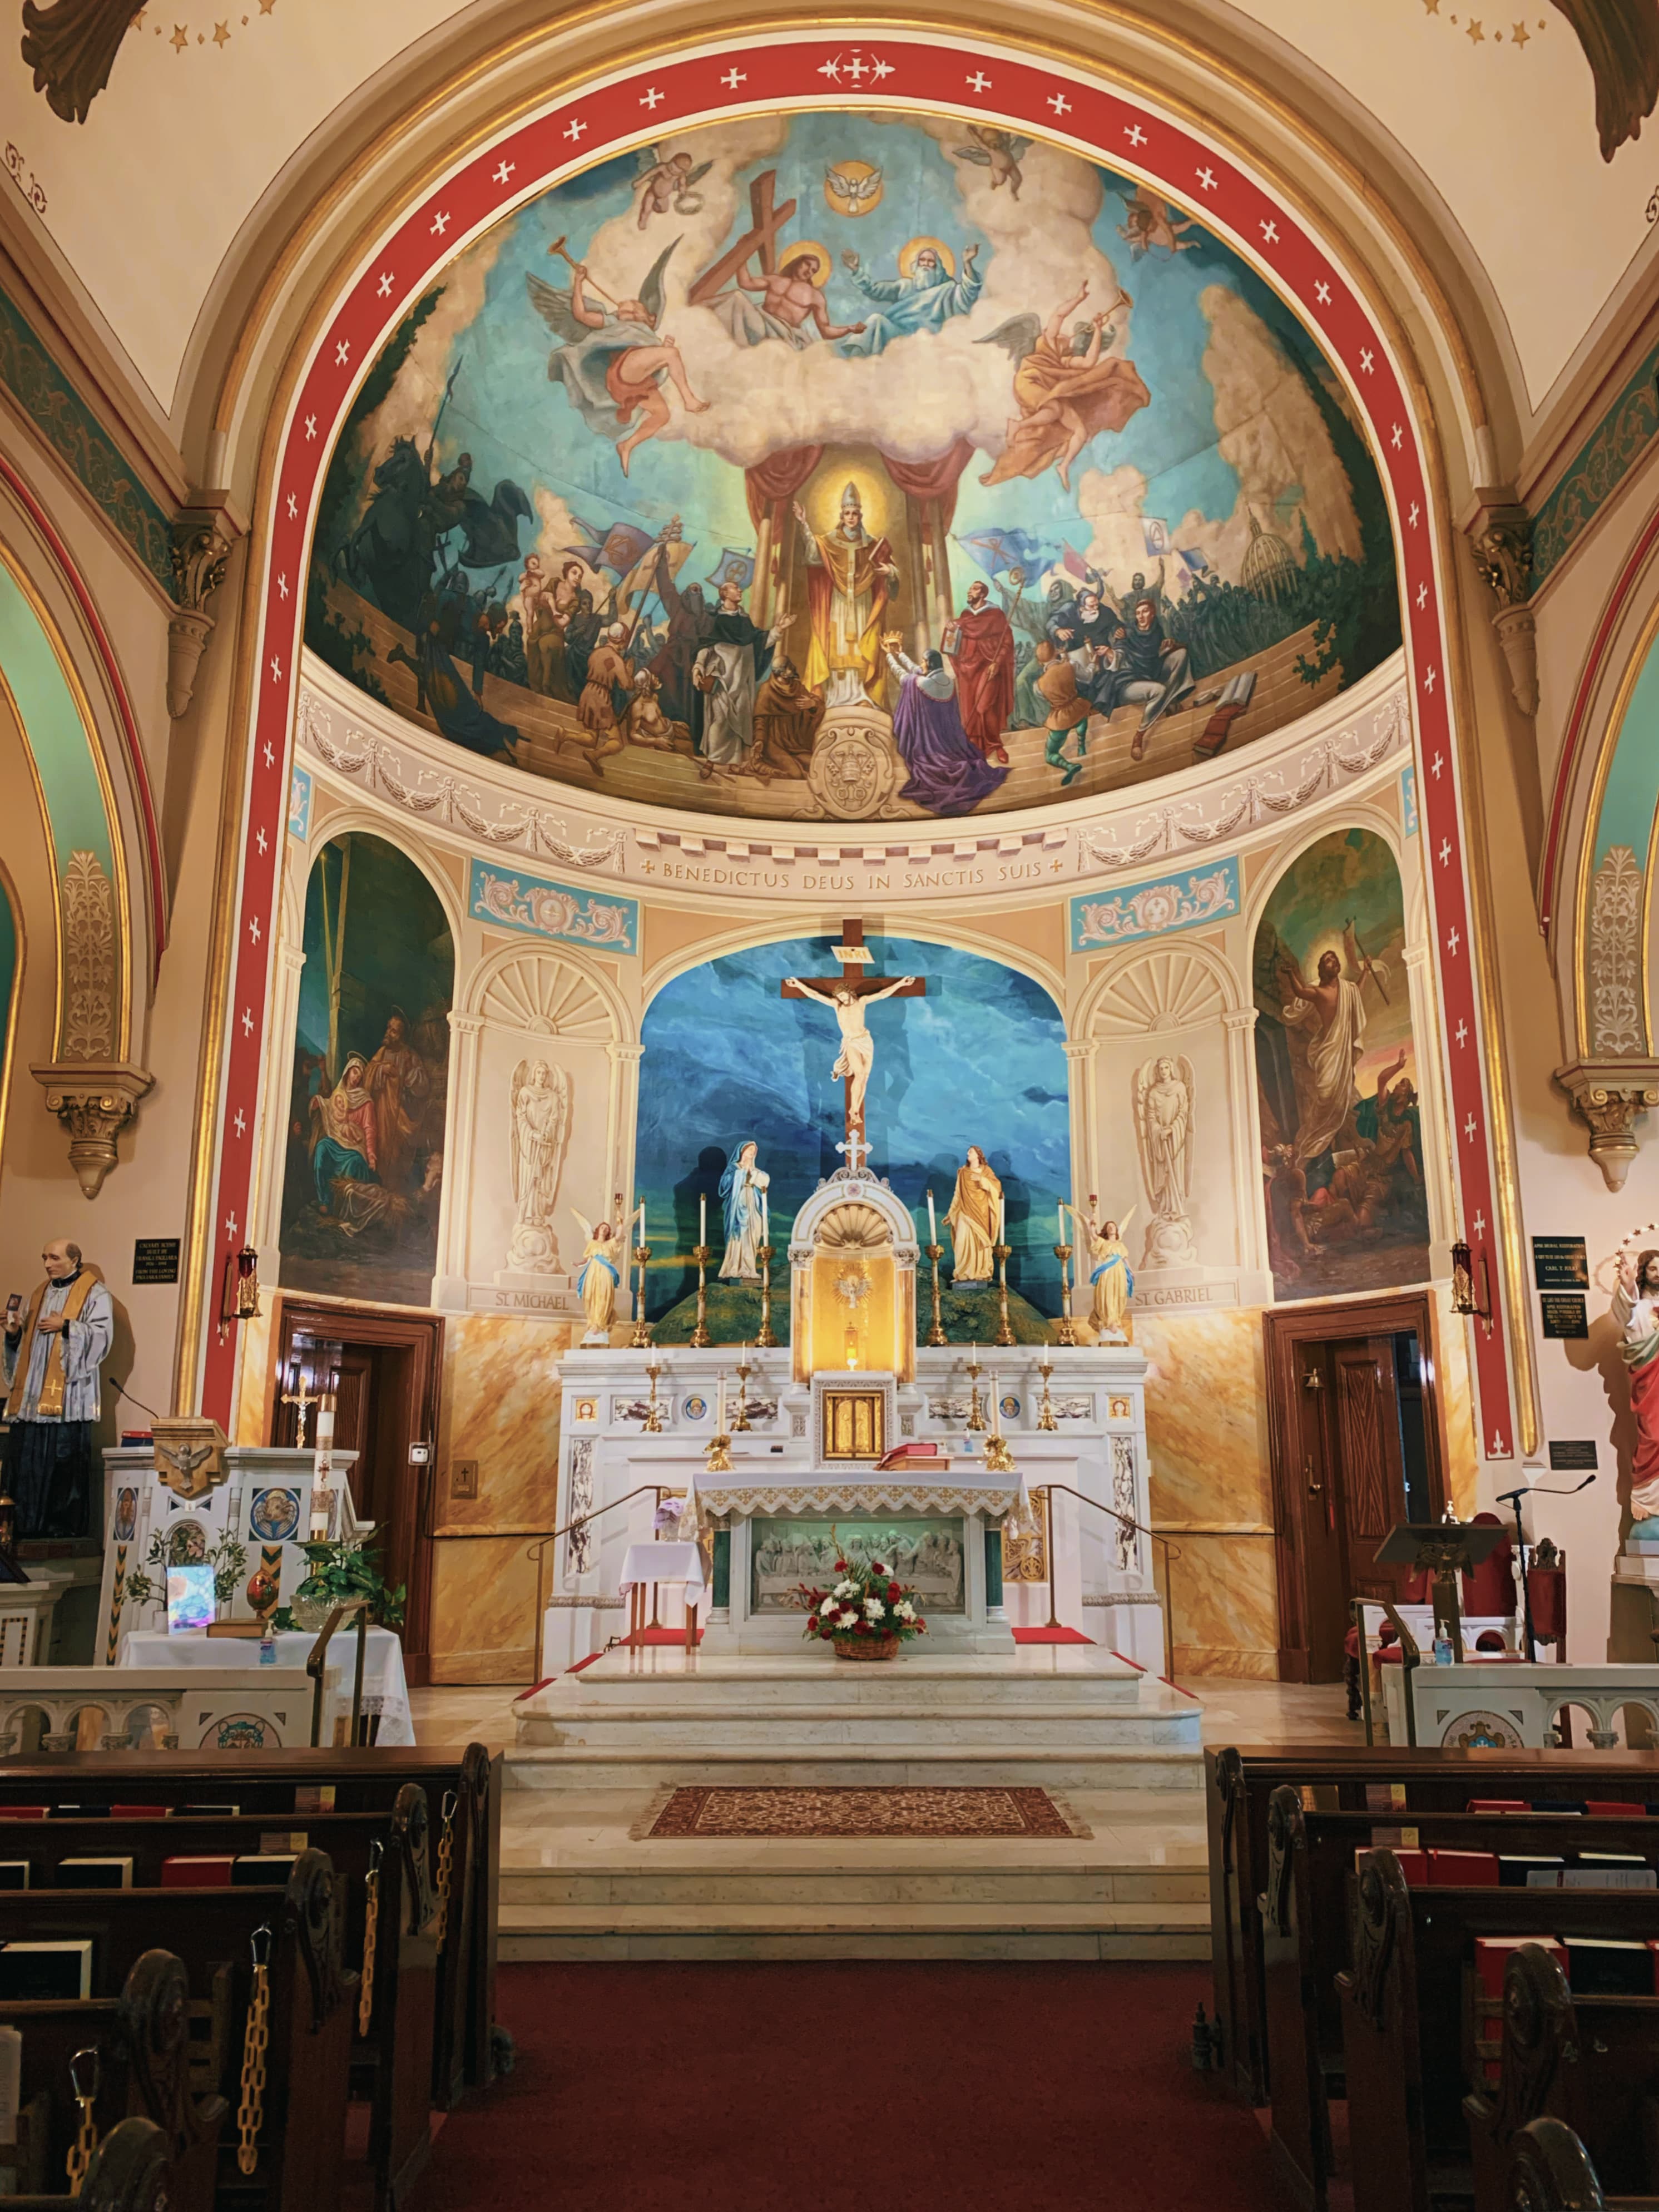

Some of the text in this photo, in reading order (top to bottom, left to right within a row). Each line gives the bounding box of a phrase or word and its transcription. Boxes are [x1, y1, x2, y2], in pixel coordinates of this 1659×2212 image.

[662, 861, 1041, 890] BENEDICTUS DEUS IN SANCTIS SUIS
[514, 1294, 569, 1310] MICHAEL
[1155, 1287, 1213, 1305] GABRIEL
